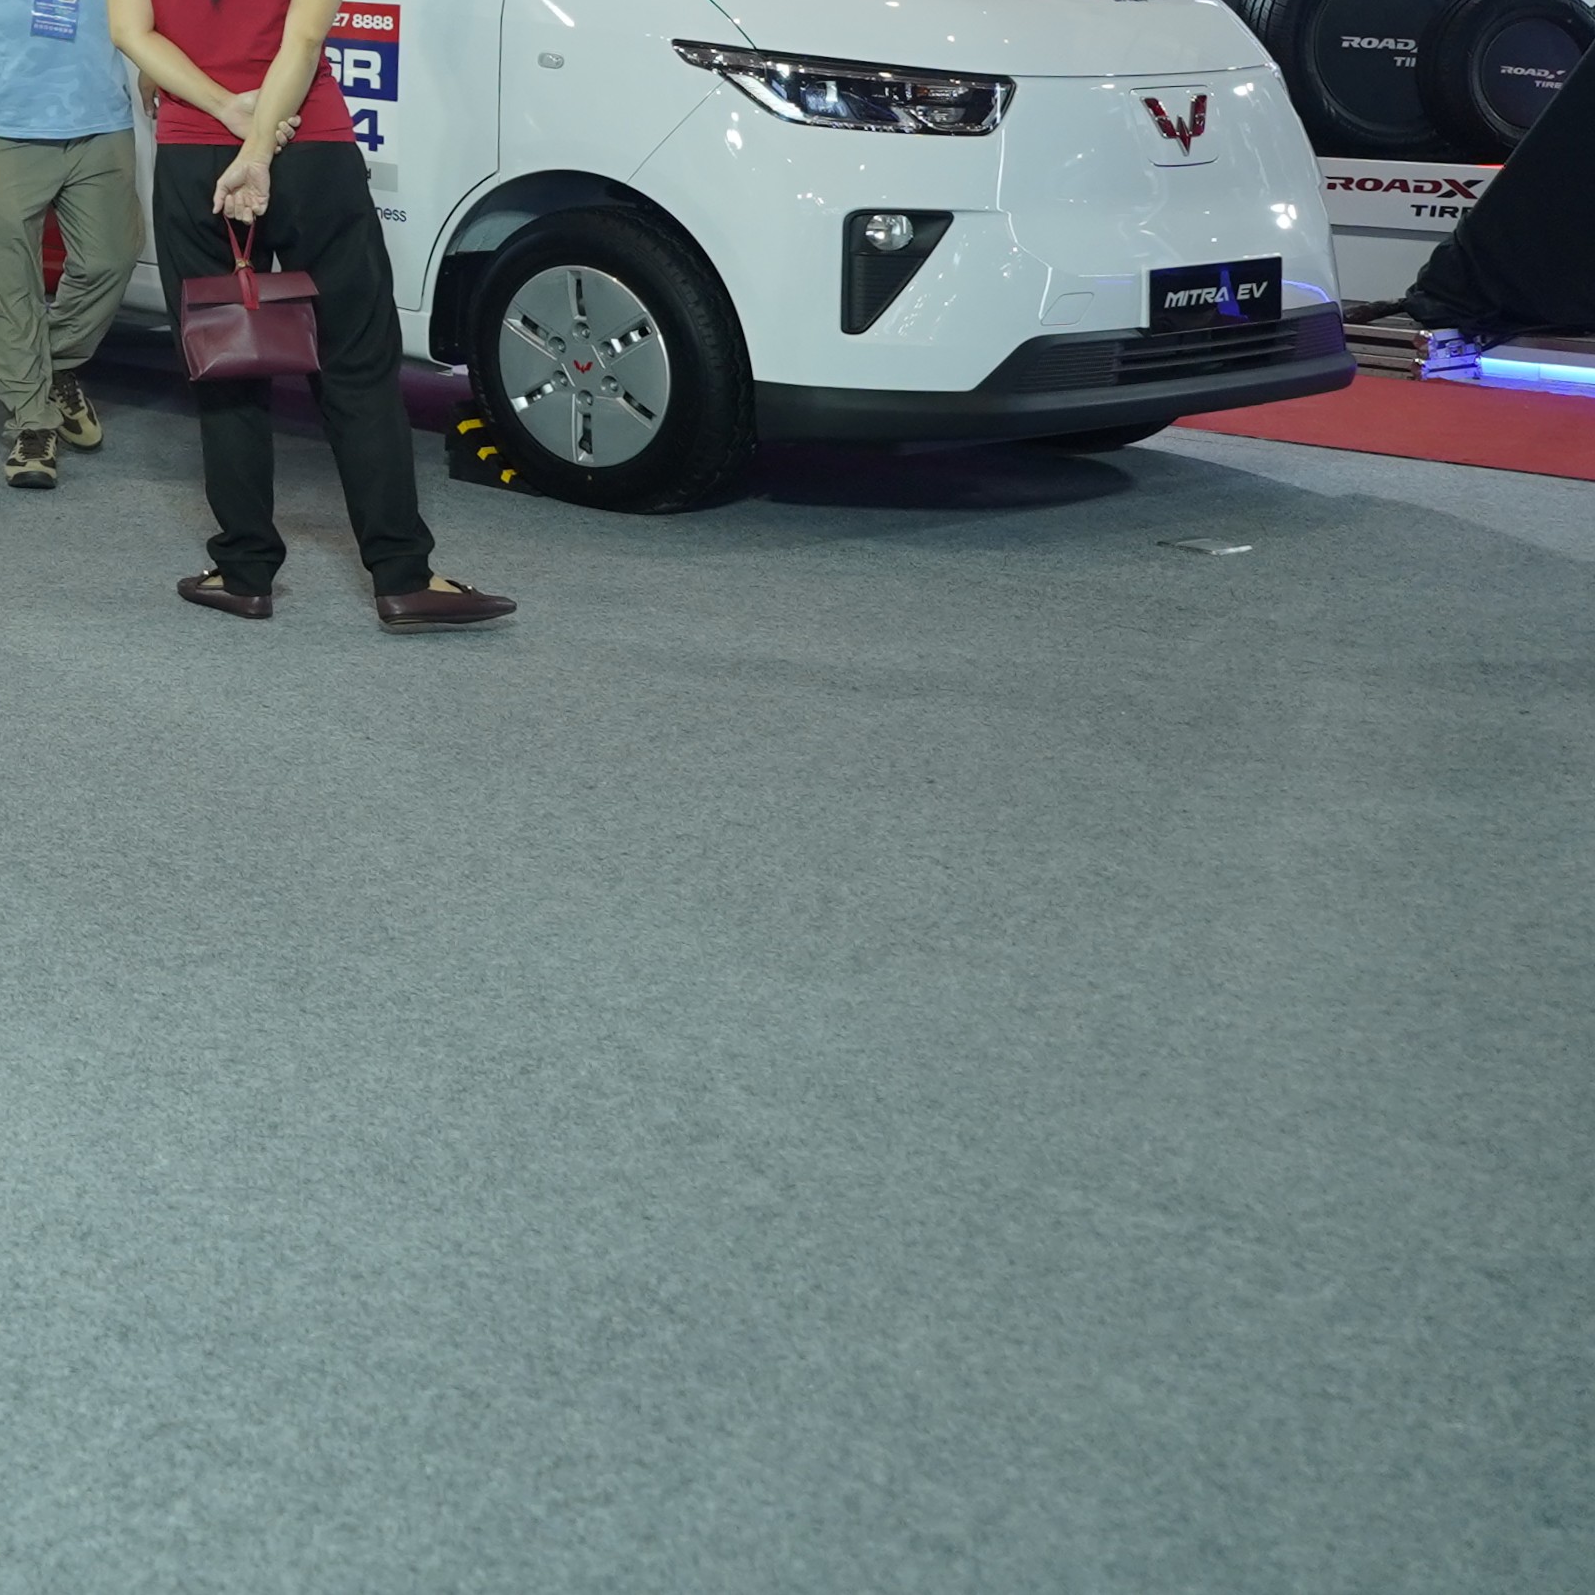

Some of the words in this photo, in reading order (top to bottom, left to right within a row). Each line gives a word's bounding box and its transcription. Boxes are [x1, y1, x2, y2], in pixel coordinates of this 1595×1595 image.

[352, 13, 394, 30] 8888
[1341, 36, 1418, 53] ROAD
[1325, 176, 1484, 199] ROADX
[1164, 287, 1230, 308] MITRA
[1237, 281, 1268, 300] EV
